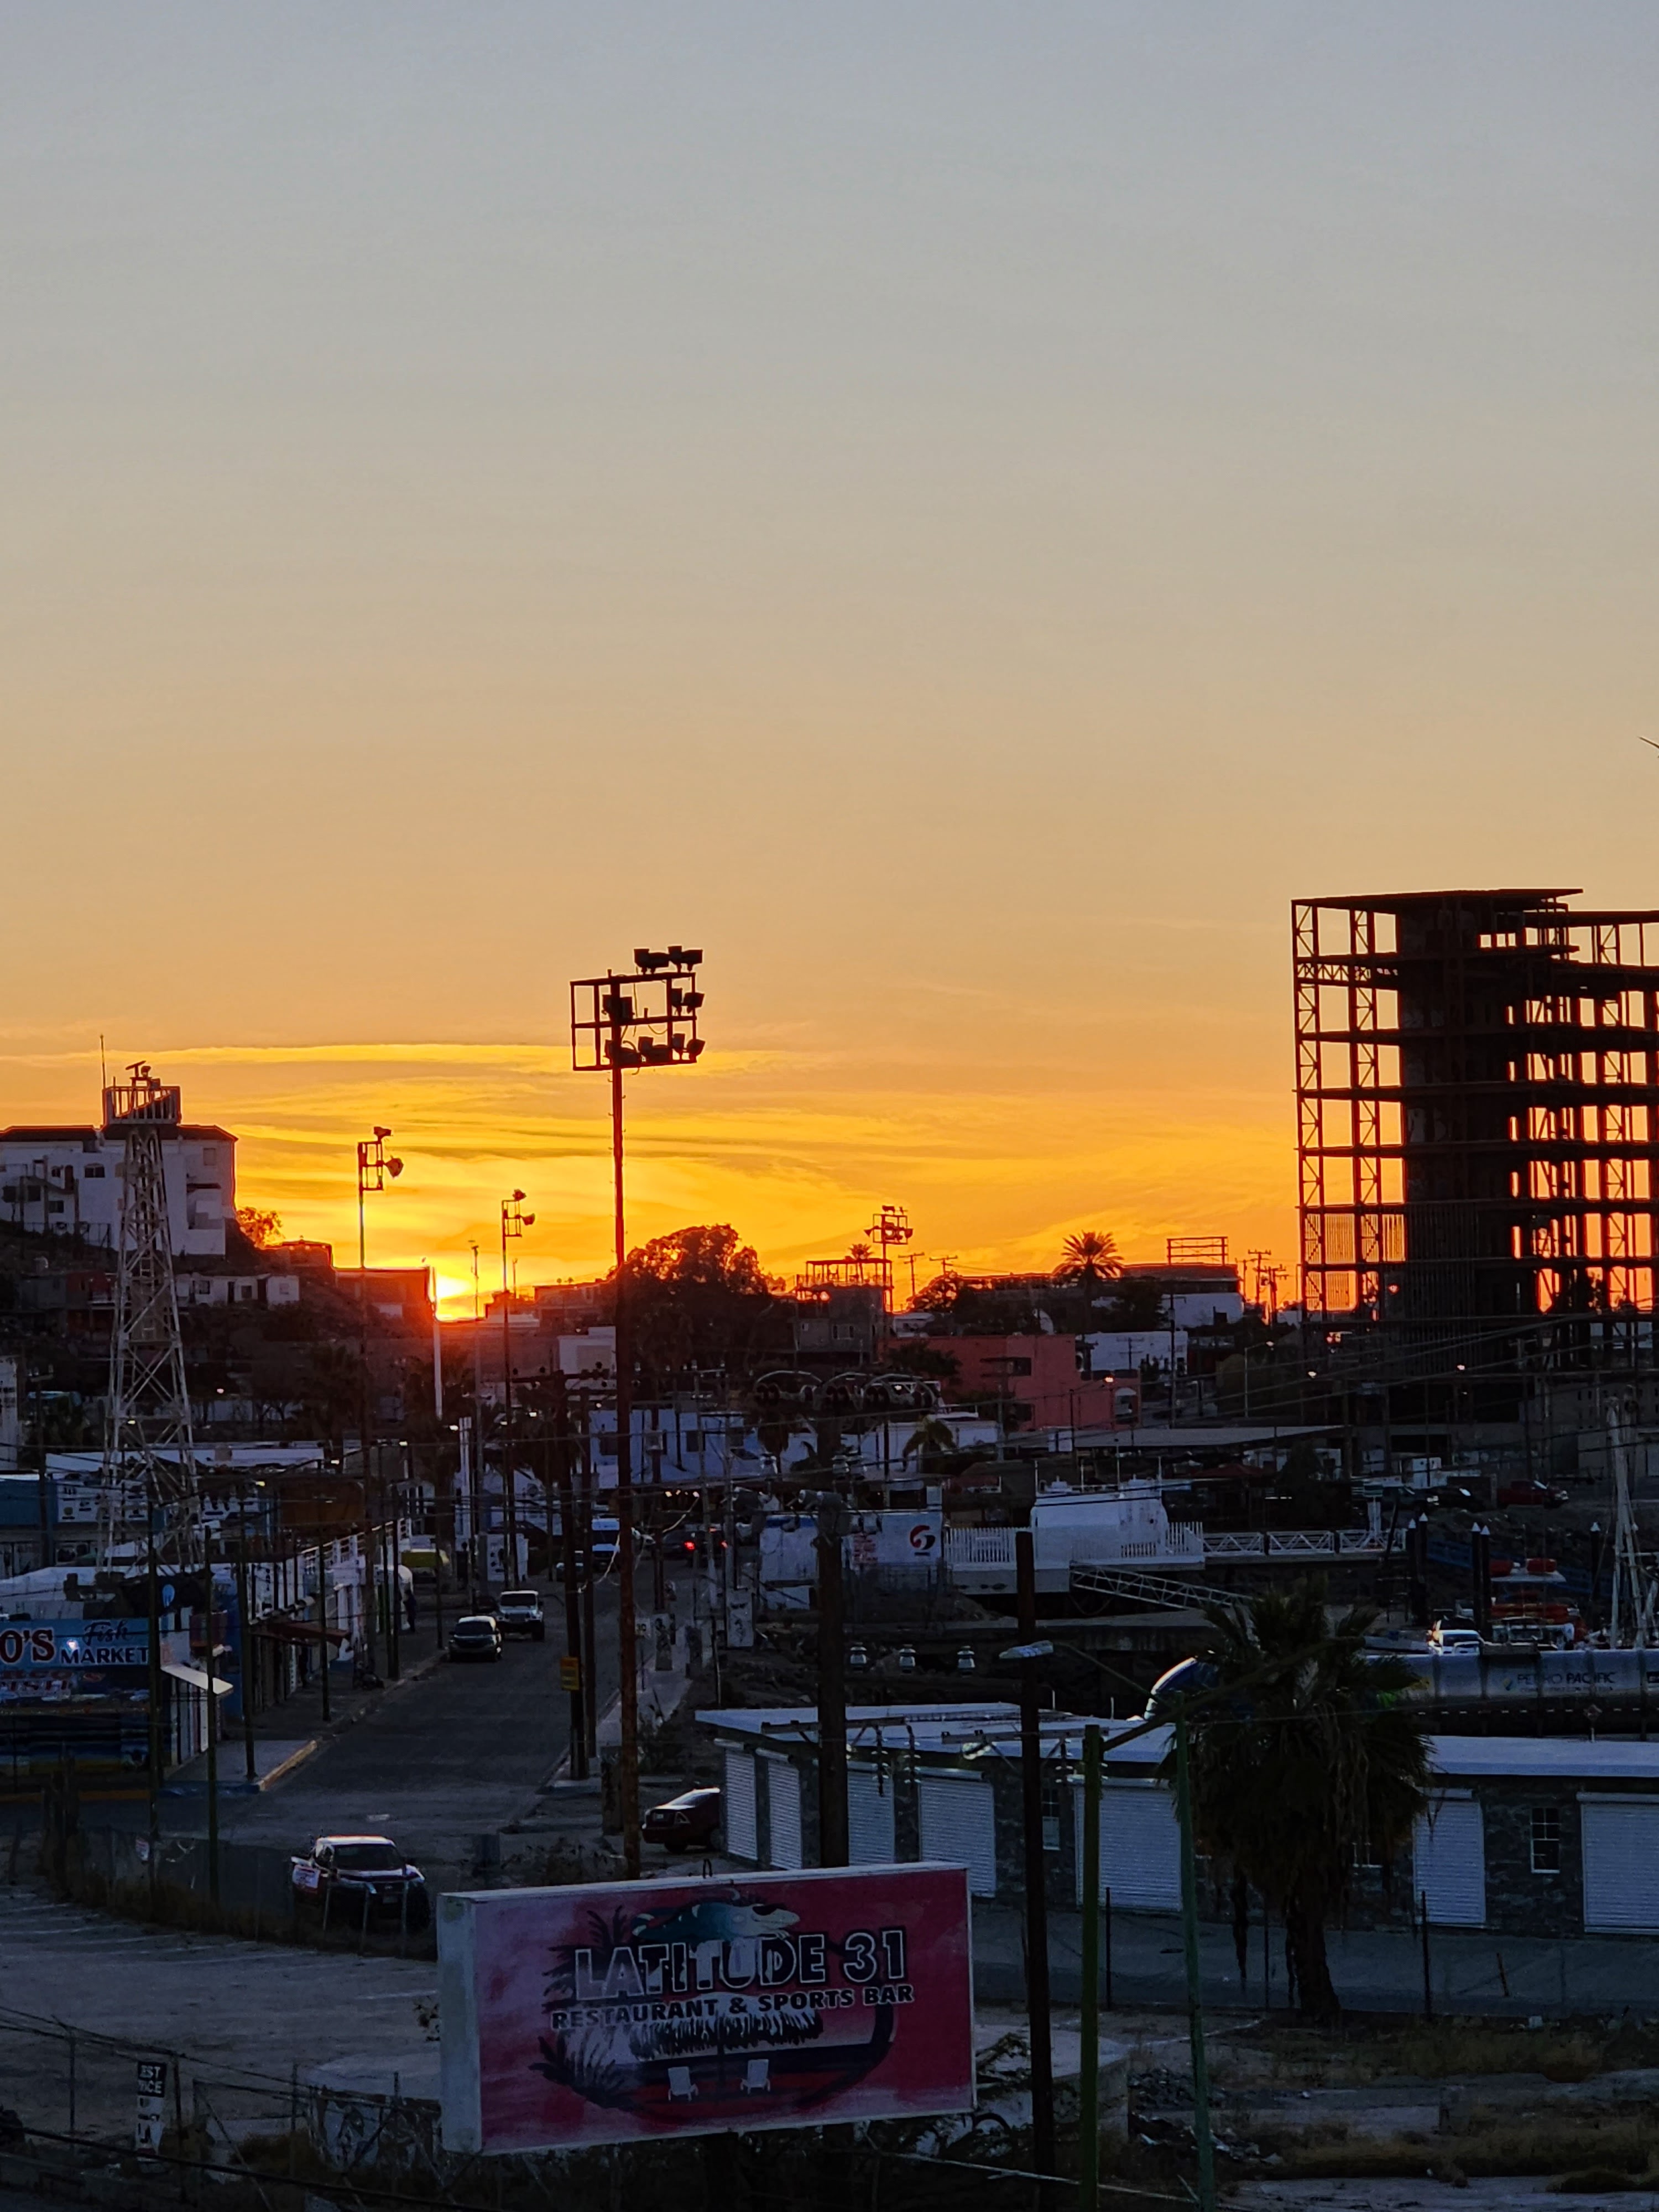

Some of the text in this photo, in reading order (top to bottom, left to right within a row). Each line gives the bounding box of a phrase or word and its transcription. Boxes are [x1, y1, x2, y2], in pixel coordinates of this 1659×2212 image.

[0, 1629, 54, 1663] O'S
[84, 1620, 128, 1646] Fish
[60, 1647, 149, 1664] MARKET
[574, 1929, 906, 2001] LATITUDE 31
[551, 1984, 915, 2030] RESTAURANT & SPORTS BAR
